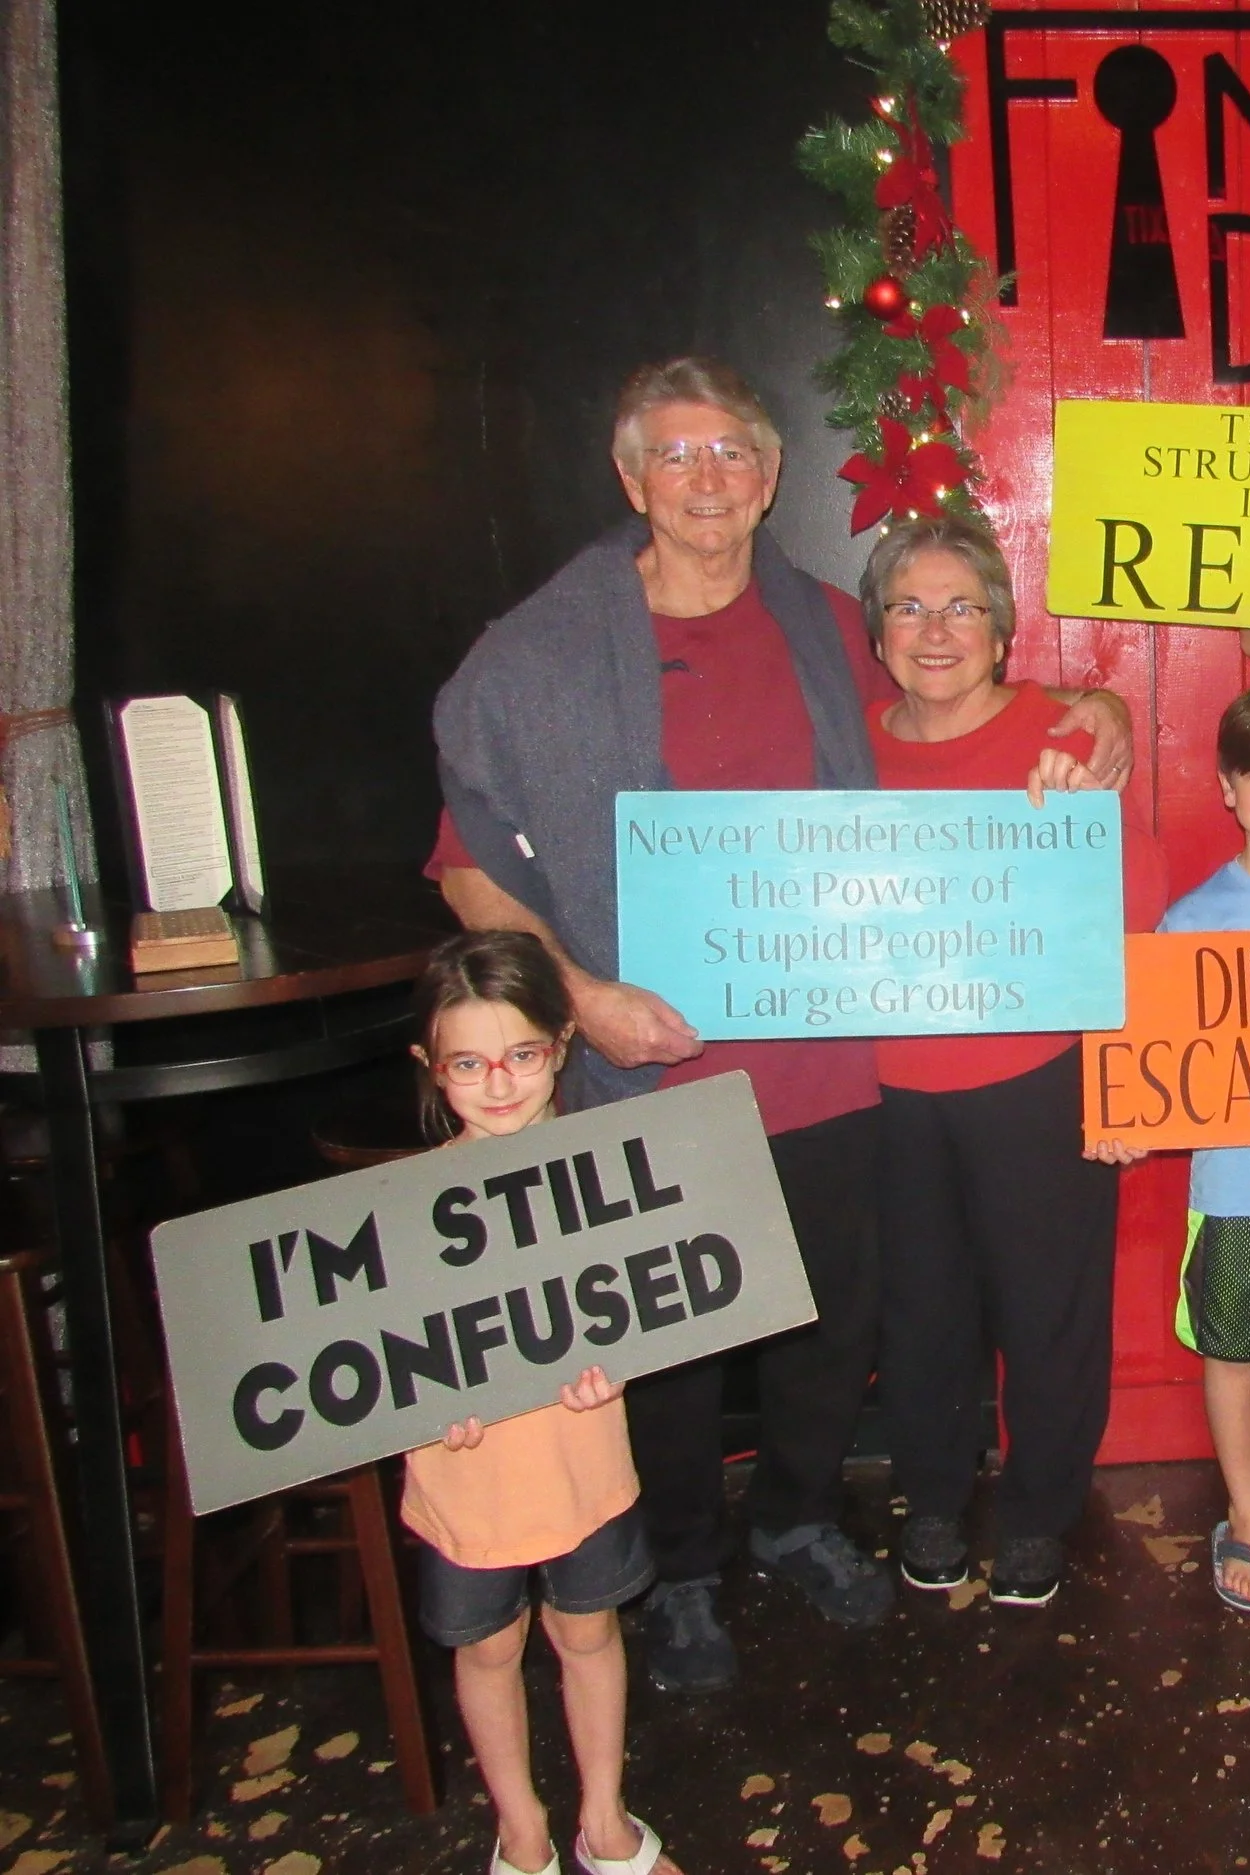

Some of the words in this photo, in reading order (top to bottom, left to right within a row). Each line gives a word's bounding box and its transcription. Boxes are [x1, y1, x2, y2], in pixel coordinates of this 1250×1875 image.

[628, 818, 765, 857] Never
[776, 813, 1108, 854] Underestimate
[726, 869, 801, 909] the
[812, 871, 960, 908] Power
[971, 865, 1020, 905] of
[703, 922, 848, 973] Stupid
[859, 919, 999, 969] People
[1008, 921, 1045, 957] in
[725, 982, 858, 1026] Large
[869, 977, 1025, 1021] Groups
[249, 1210, 389, 1323] I'M
[432, 1136, 684, 1267] STILL
[232, 1232, 743, 1451] CONFUSED
